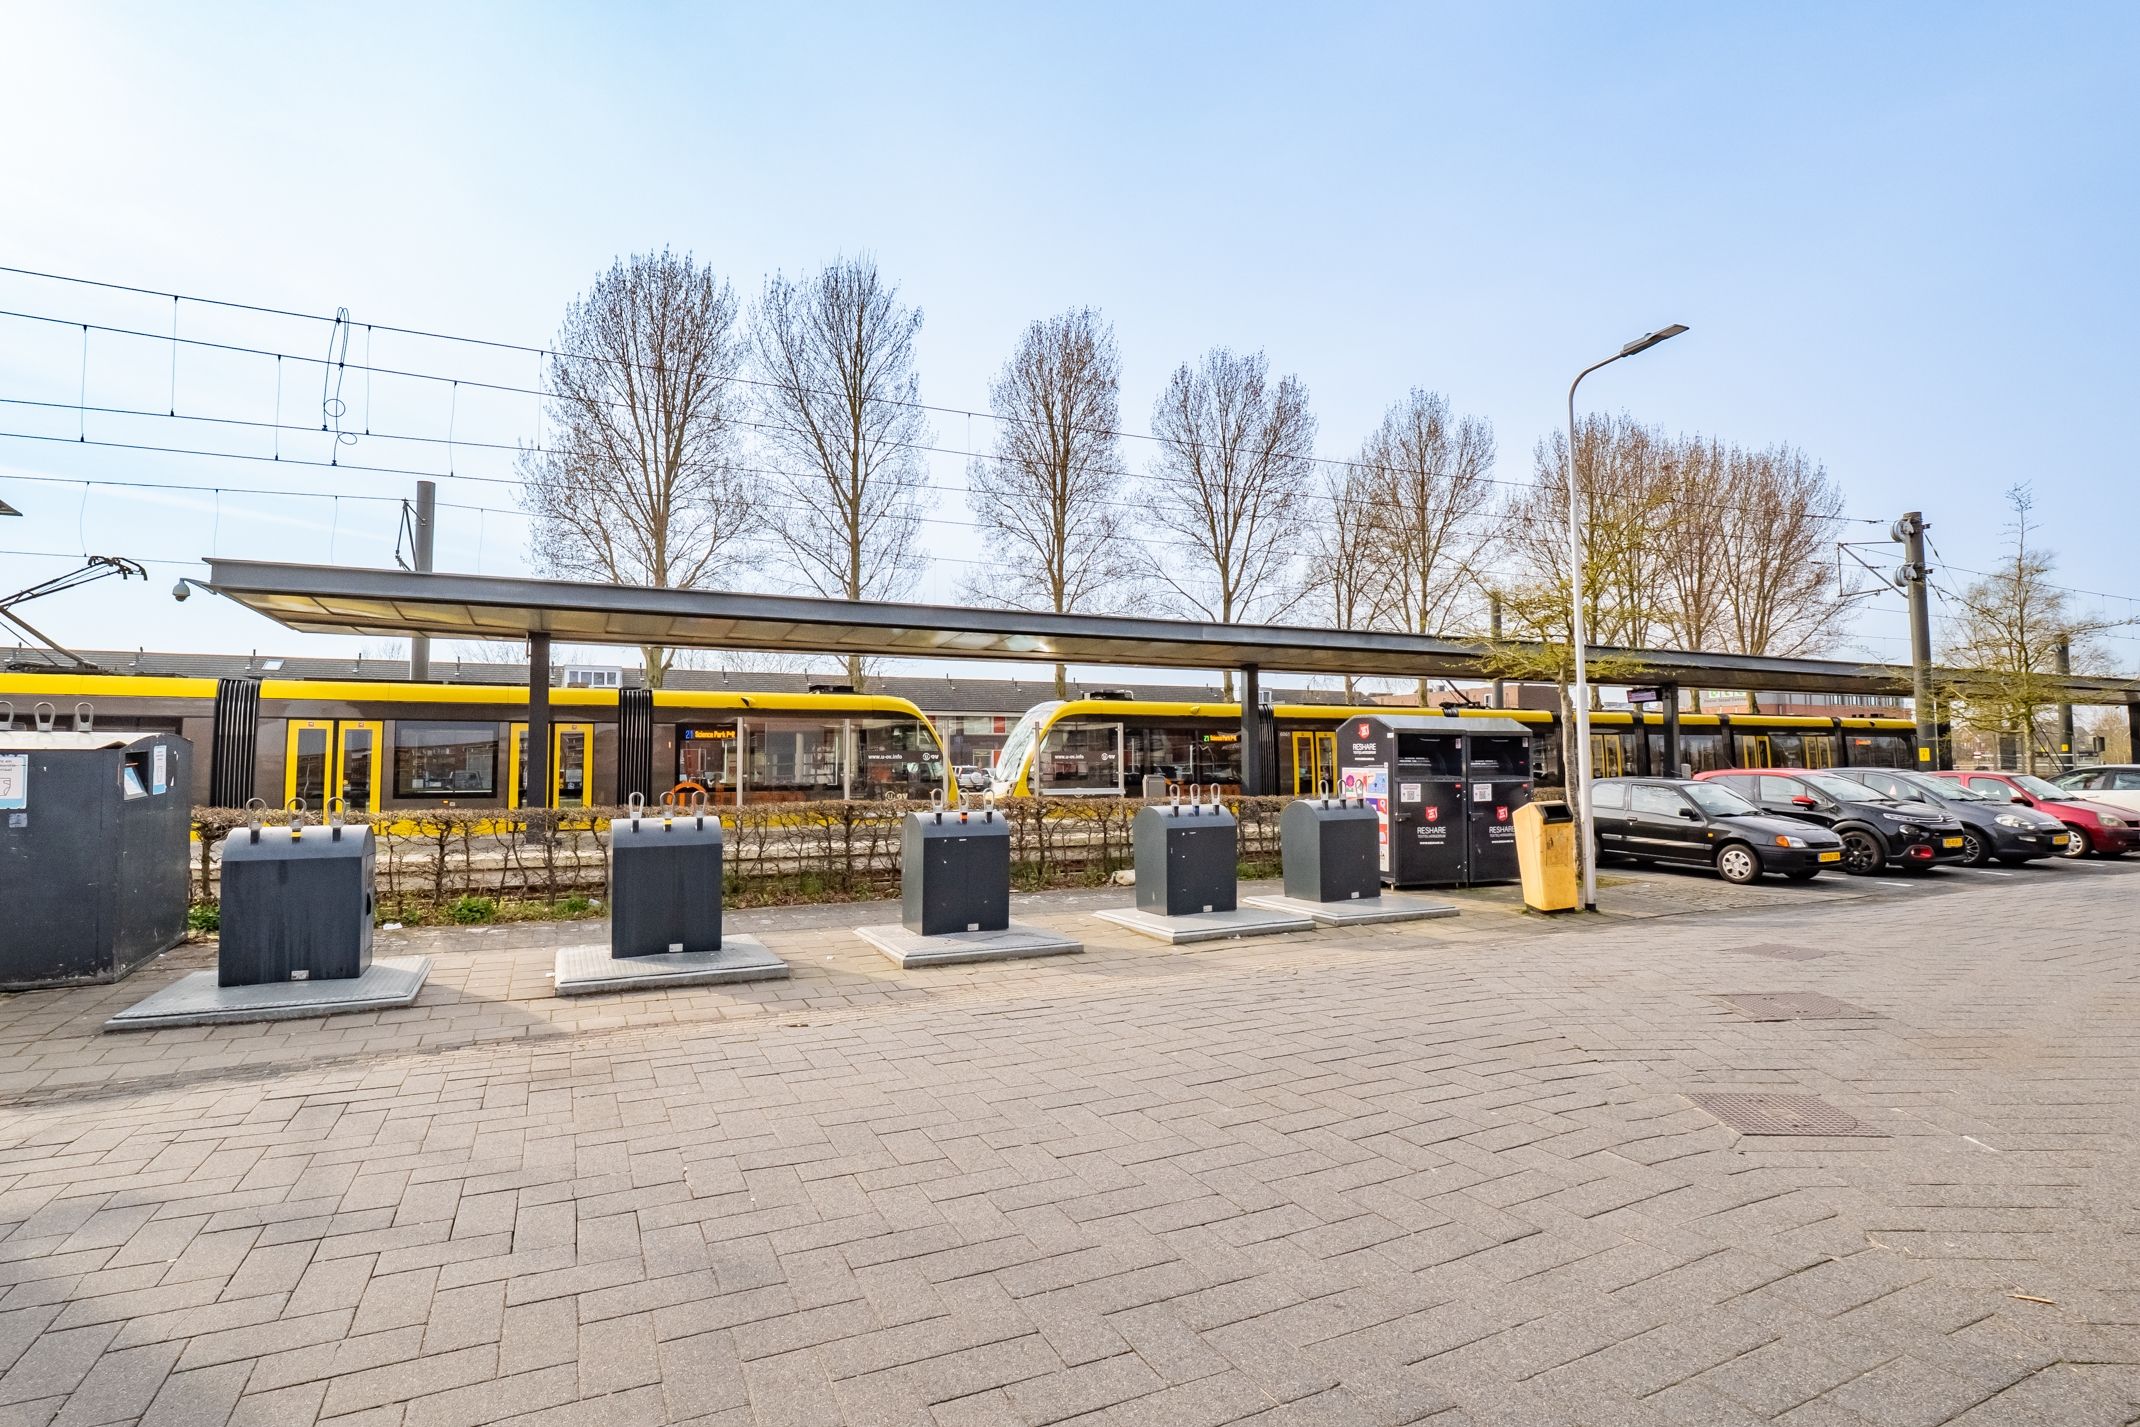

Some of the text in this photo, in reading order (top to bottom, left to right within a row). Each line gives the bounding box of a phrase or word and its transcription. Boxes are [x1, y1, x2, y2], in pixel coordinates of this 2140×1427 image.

[685, 729, 694, 739] 21
[694, 730, 713, 738] Science
[713, 730, 726, 738] Park
[1352, 743, 1376, 751] RESHARE
[1417, 826, 1446, 834] RESHARE
